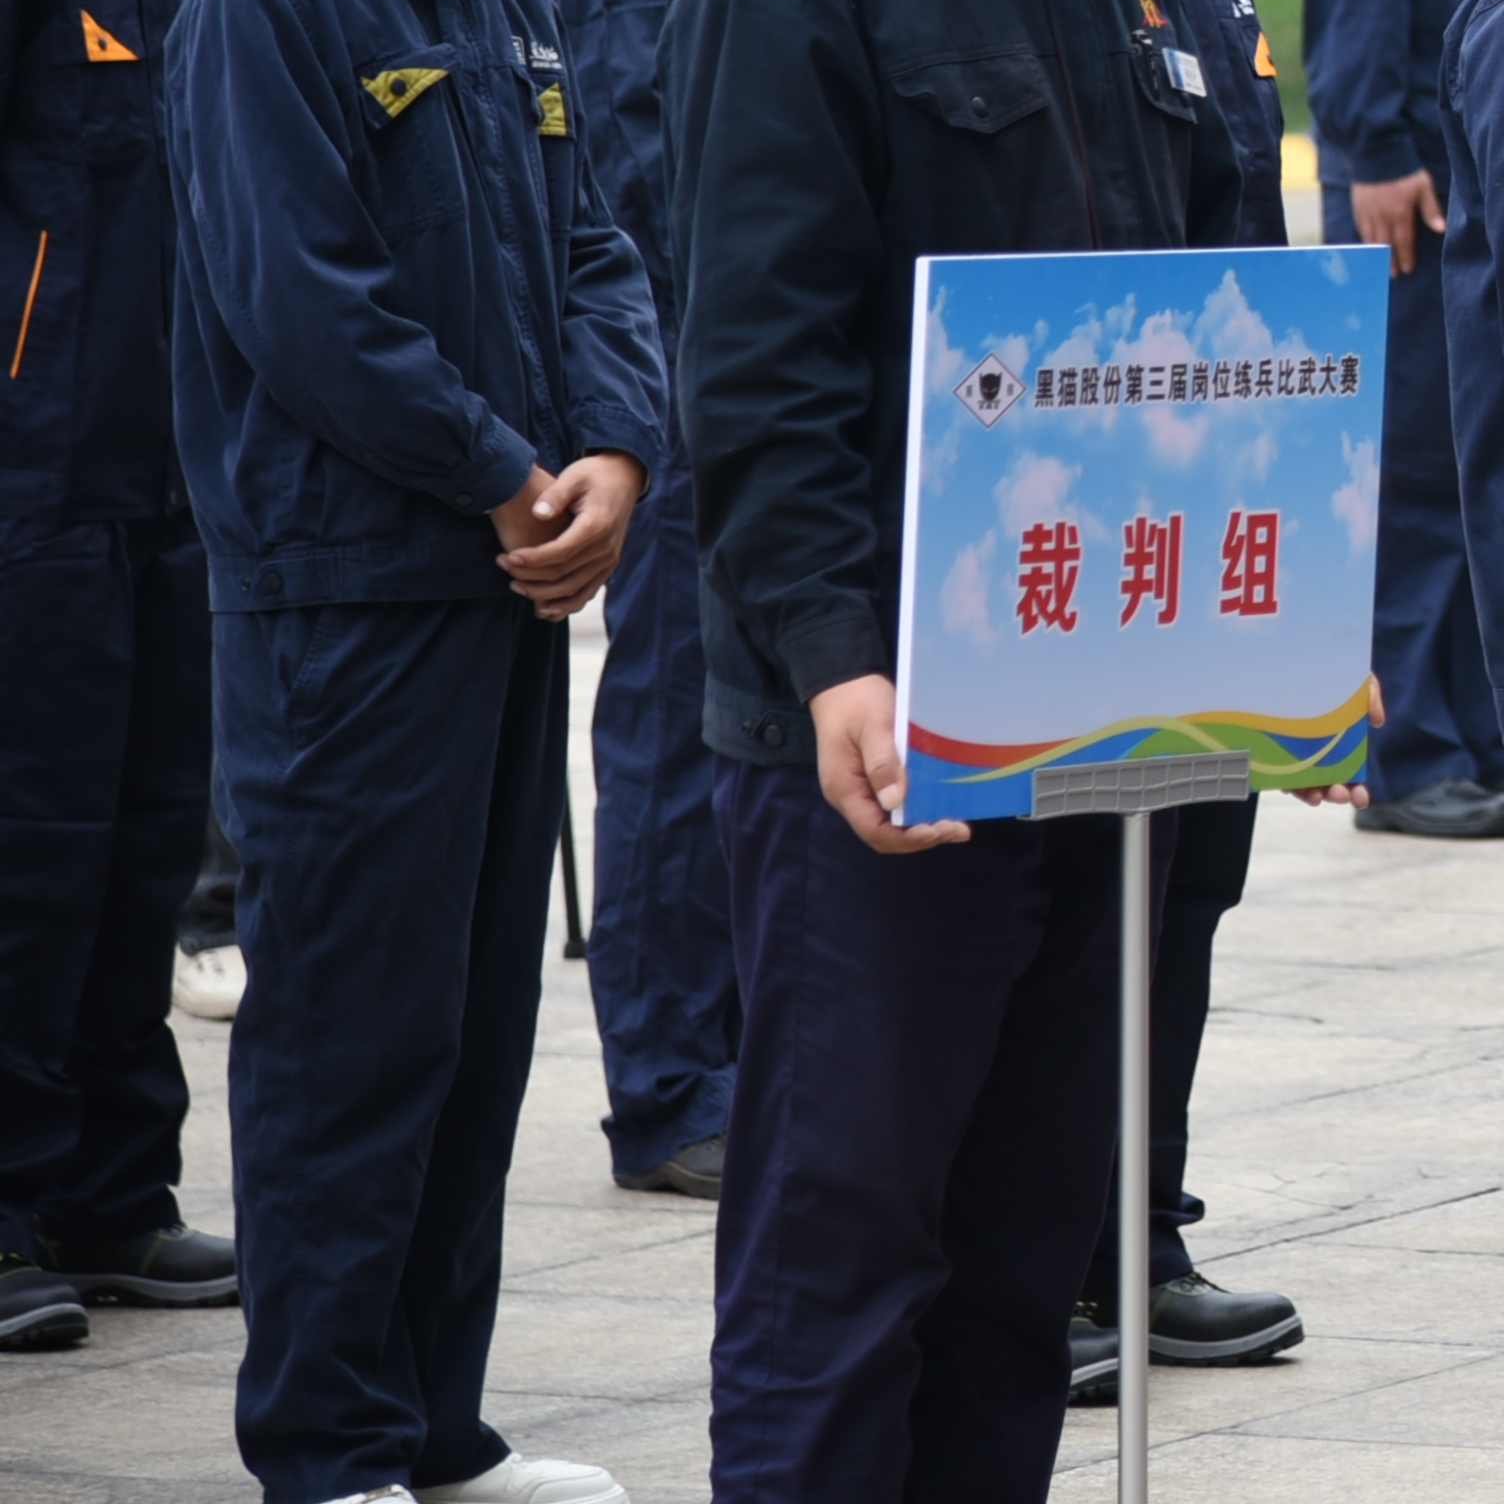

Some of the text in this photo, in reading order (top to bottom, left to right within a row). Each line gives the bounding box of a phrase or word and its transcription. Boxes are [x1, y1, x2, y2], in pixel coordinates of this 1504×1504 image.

[1033, 354, 1360, 409] 黑猫股份第三届岗位练兵比武大赛
[1015, 511, 1280, 636] 裁判组
